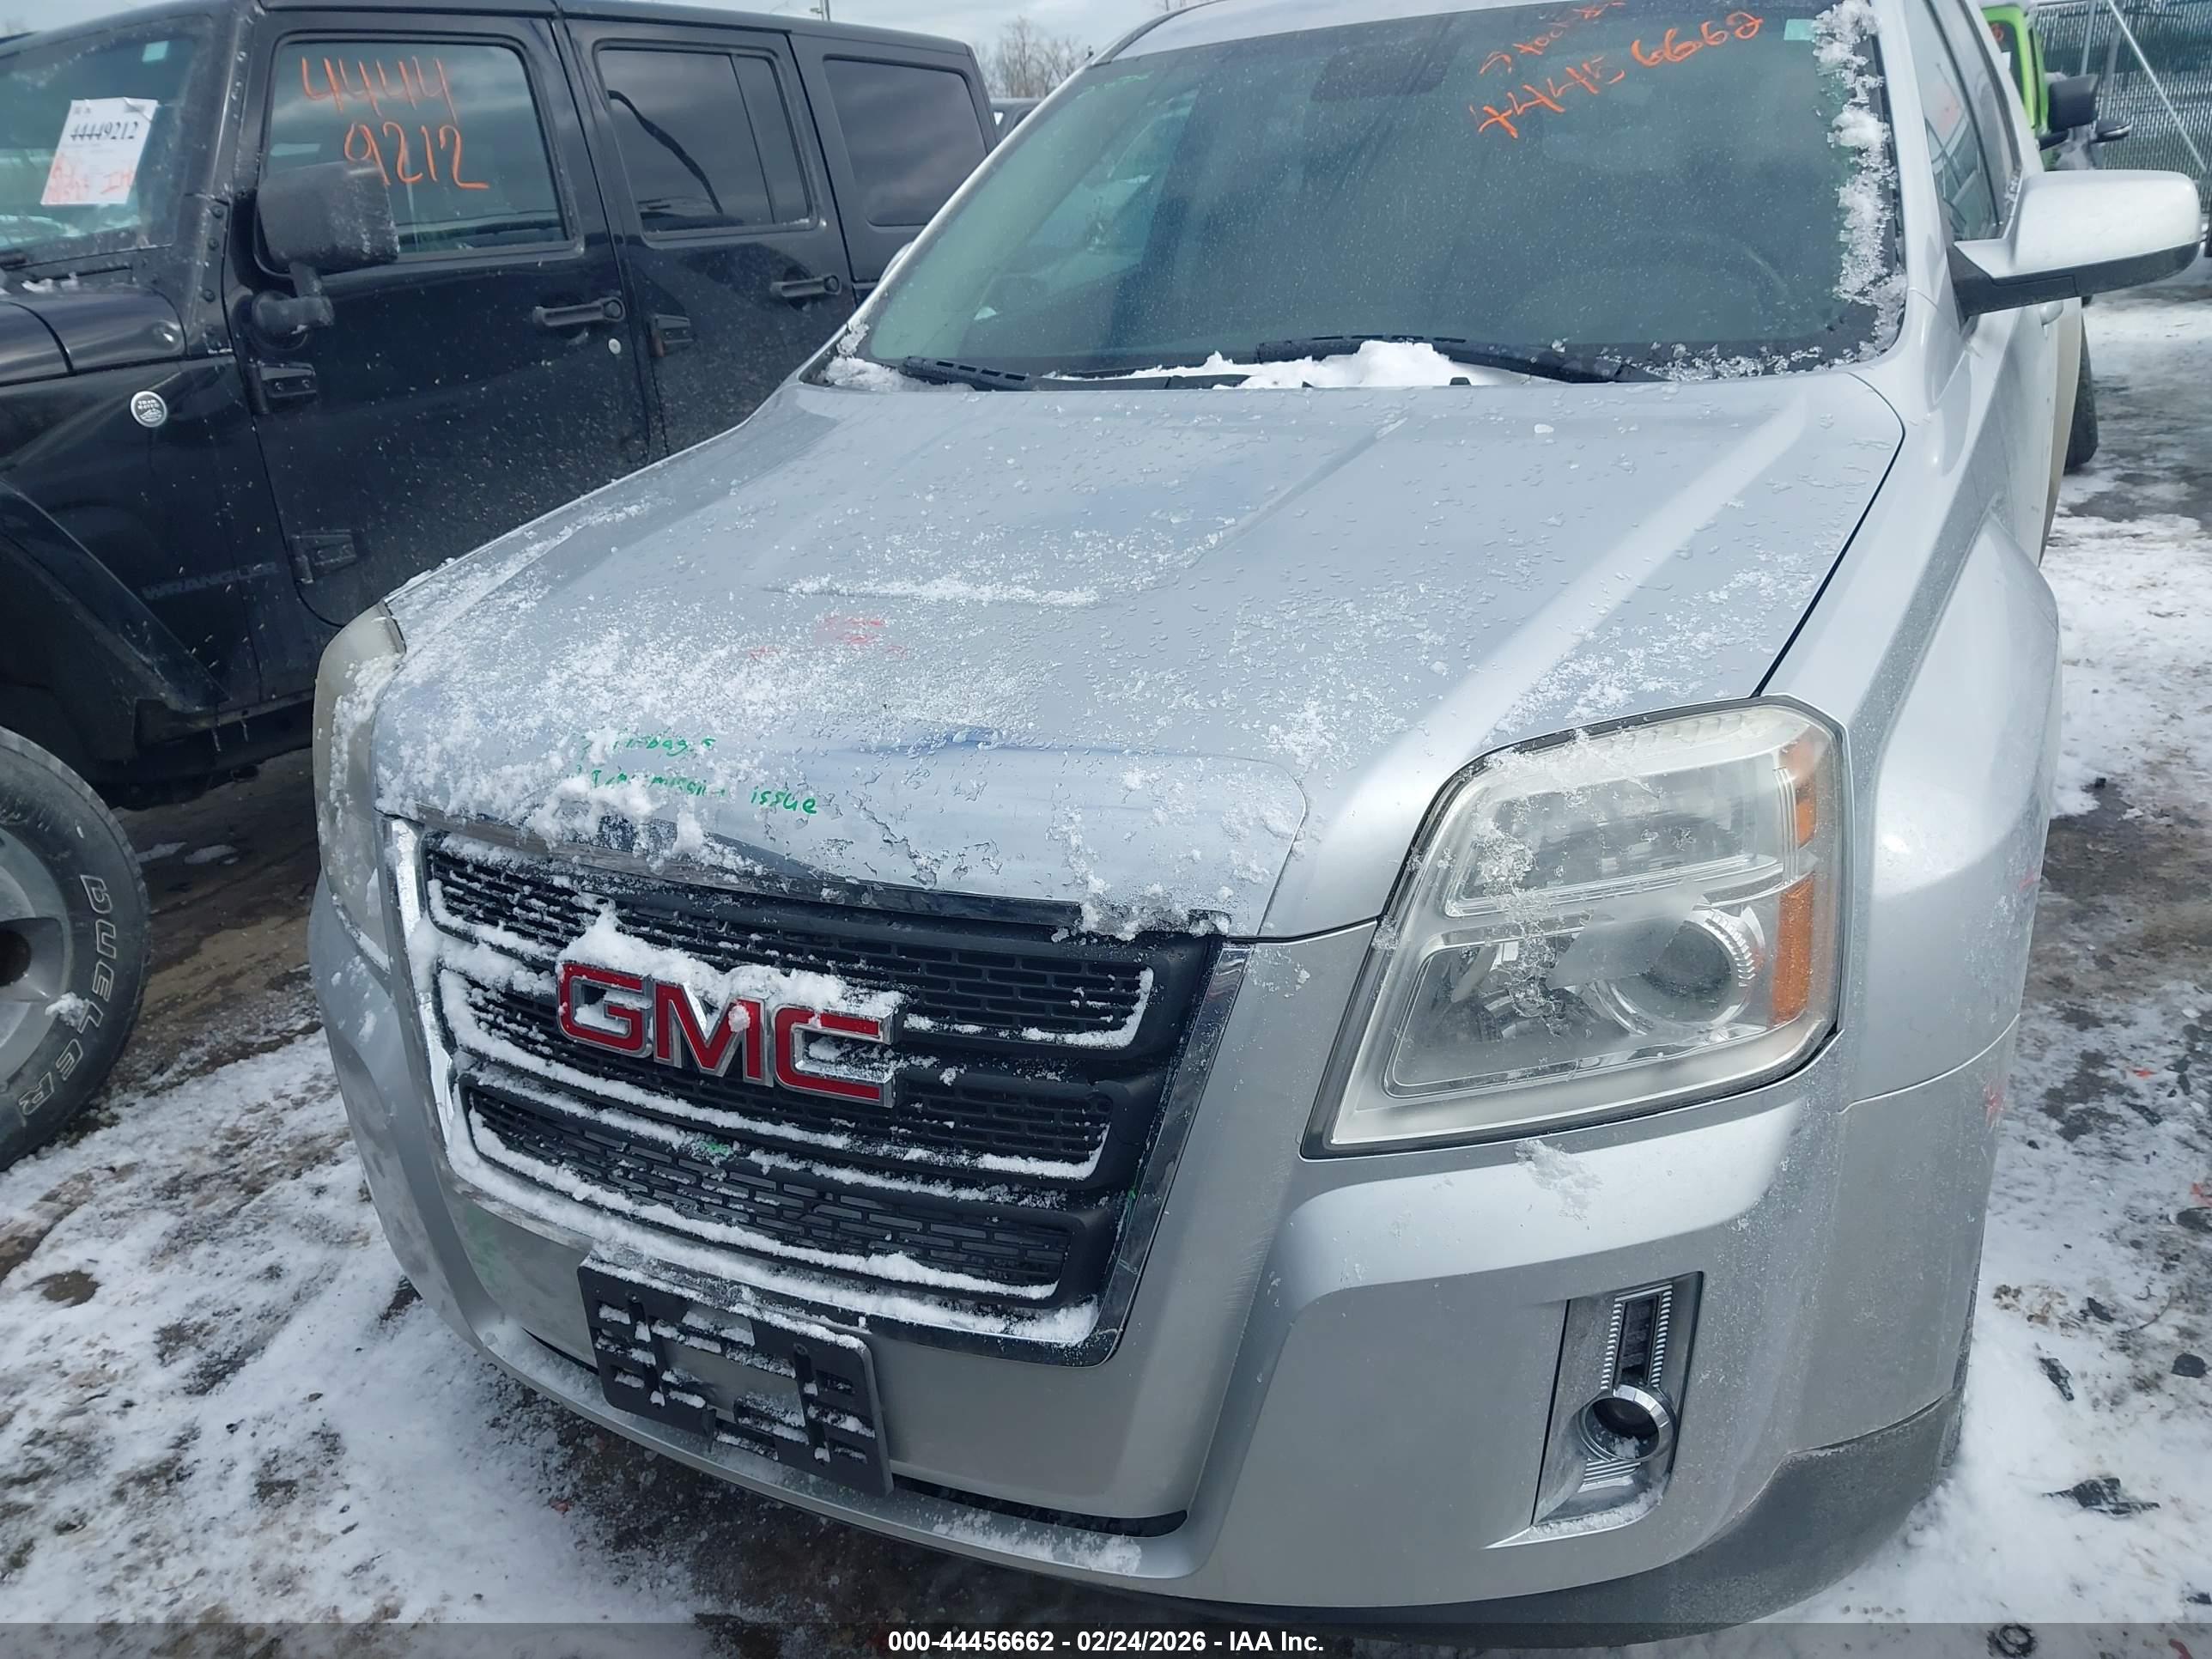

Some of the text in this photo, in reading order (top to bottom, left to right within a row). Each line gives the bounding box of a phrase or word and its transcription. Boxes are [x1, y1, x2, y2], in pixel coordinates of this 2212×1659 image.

[301, 55, 458, 125] 4444
[69, 120, 140, 142] 44449212
[343, 121, 489, 191] 9212
[750, 785, 818, 815] issue
[18, 873, 118, 1116] DUELER
[556, 960, 896, 1109] GMC
